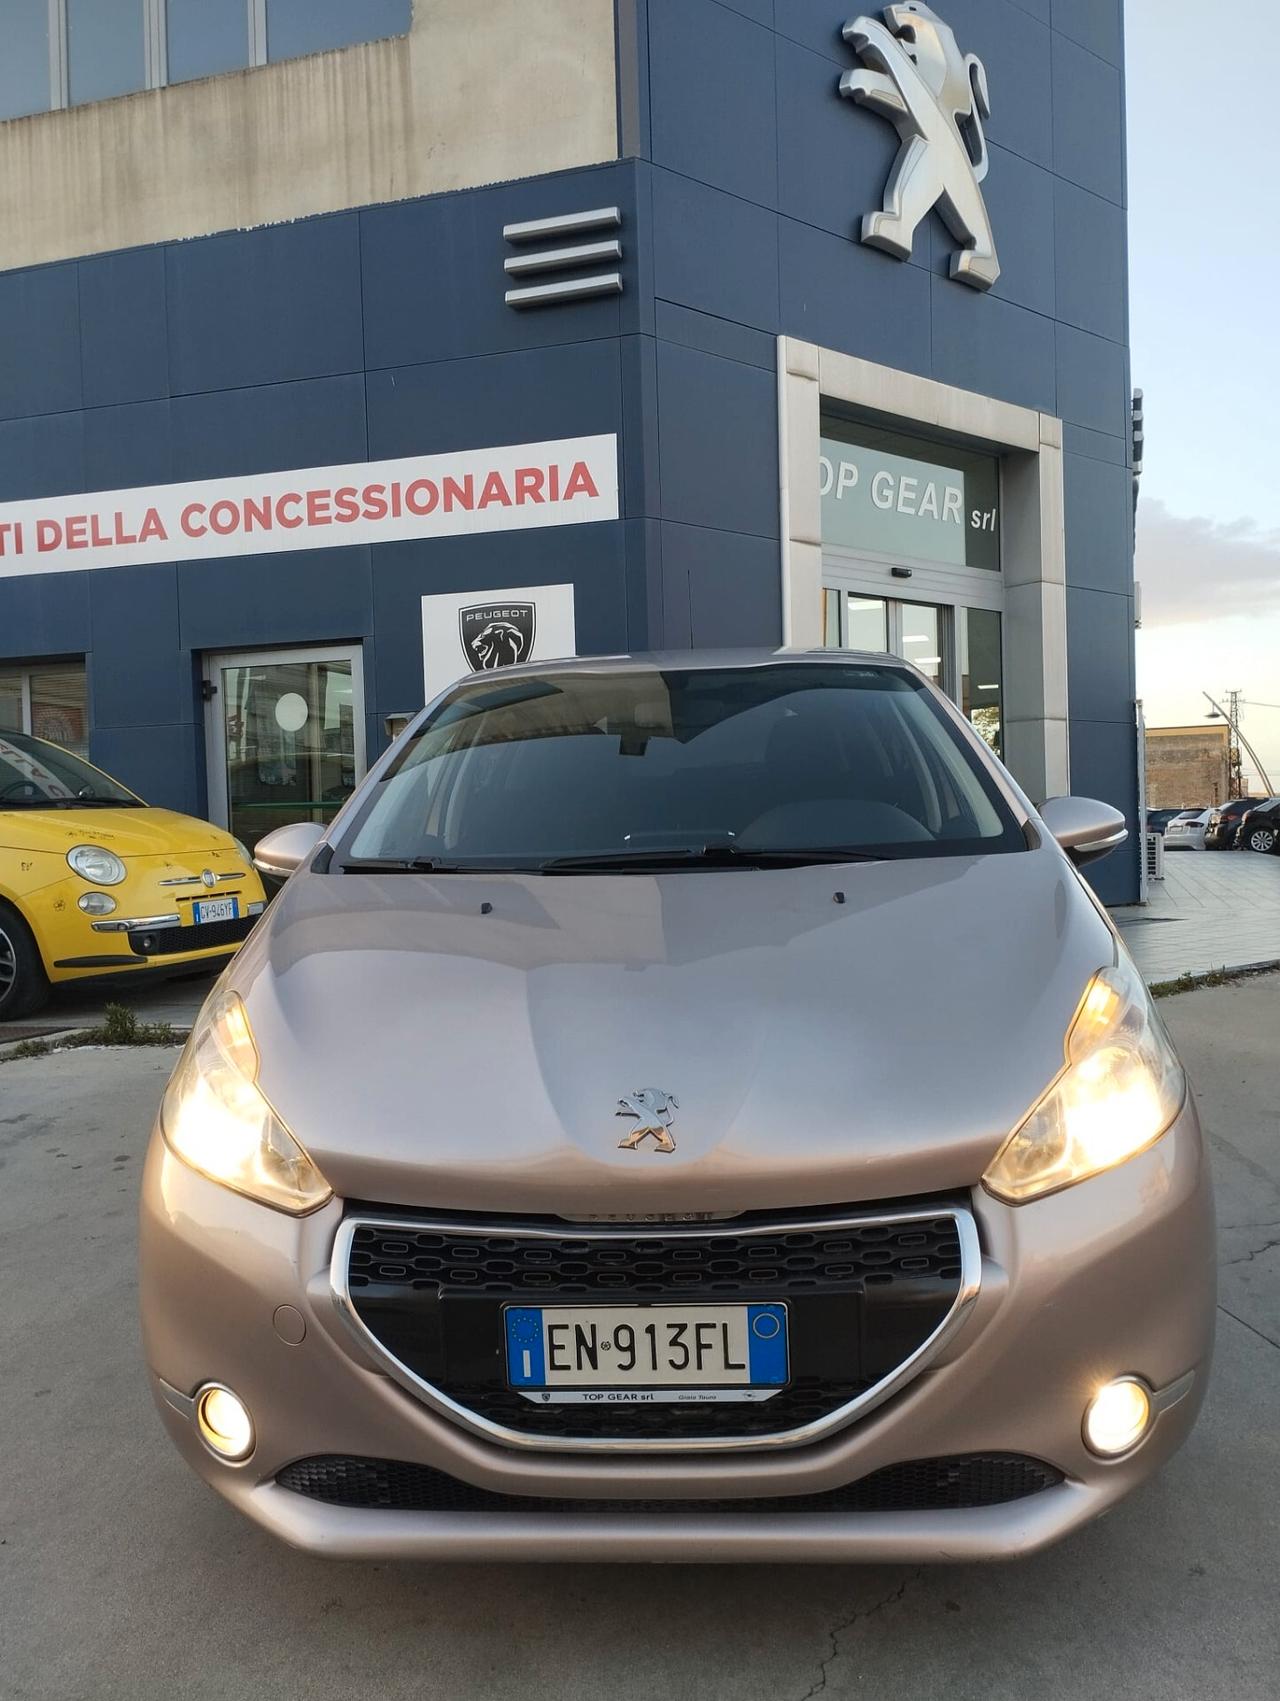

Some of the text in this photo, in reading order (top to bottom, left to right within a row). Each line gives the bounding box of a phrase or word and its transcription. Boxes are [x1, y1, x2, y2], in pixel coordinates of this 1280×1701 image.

[36, 507, 169, 552] DELLA
[180, 461, 600, 538] CONCESSIONARIA
[871, 470, 963, 524] GEAR
[970, 508, 997, 532] srl
[466, 609, 528, 622] PEUGEOT
[582, 1393, 604, 1401] TOP
[607, 1393, 638, 1401] GEAR
[640, 1392, 654, 1401] srl
